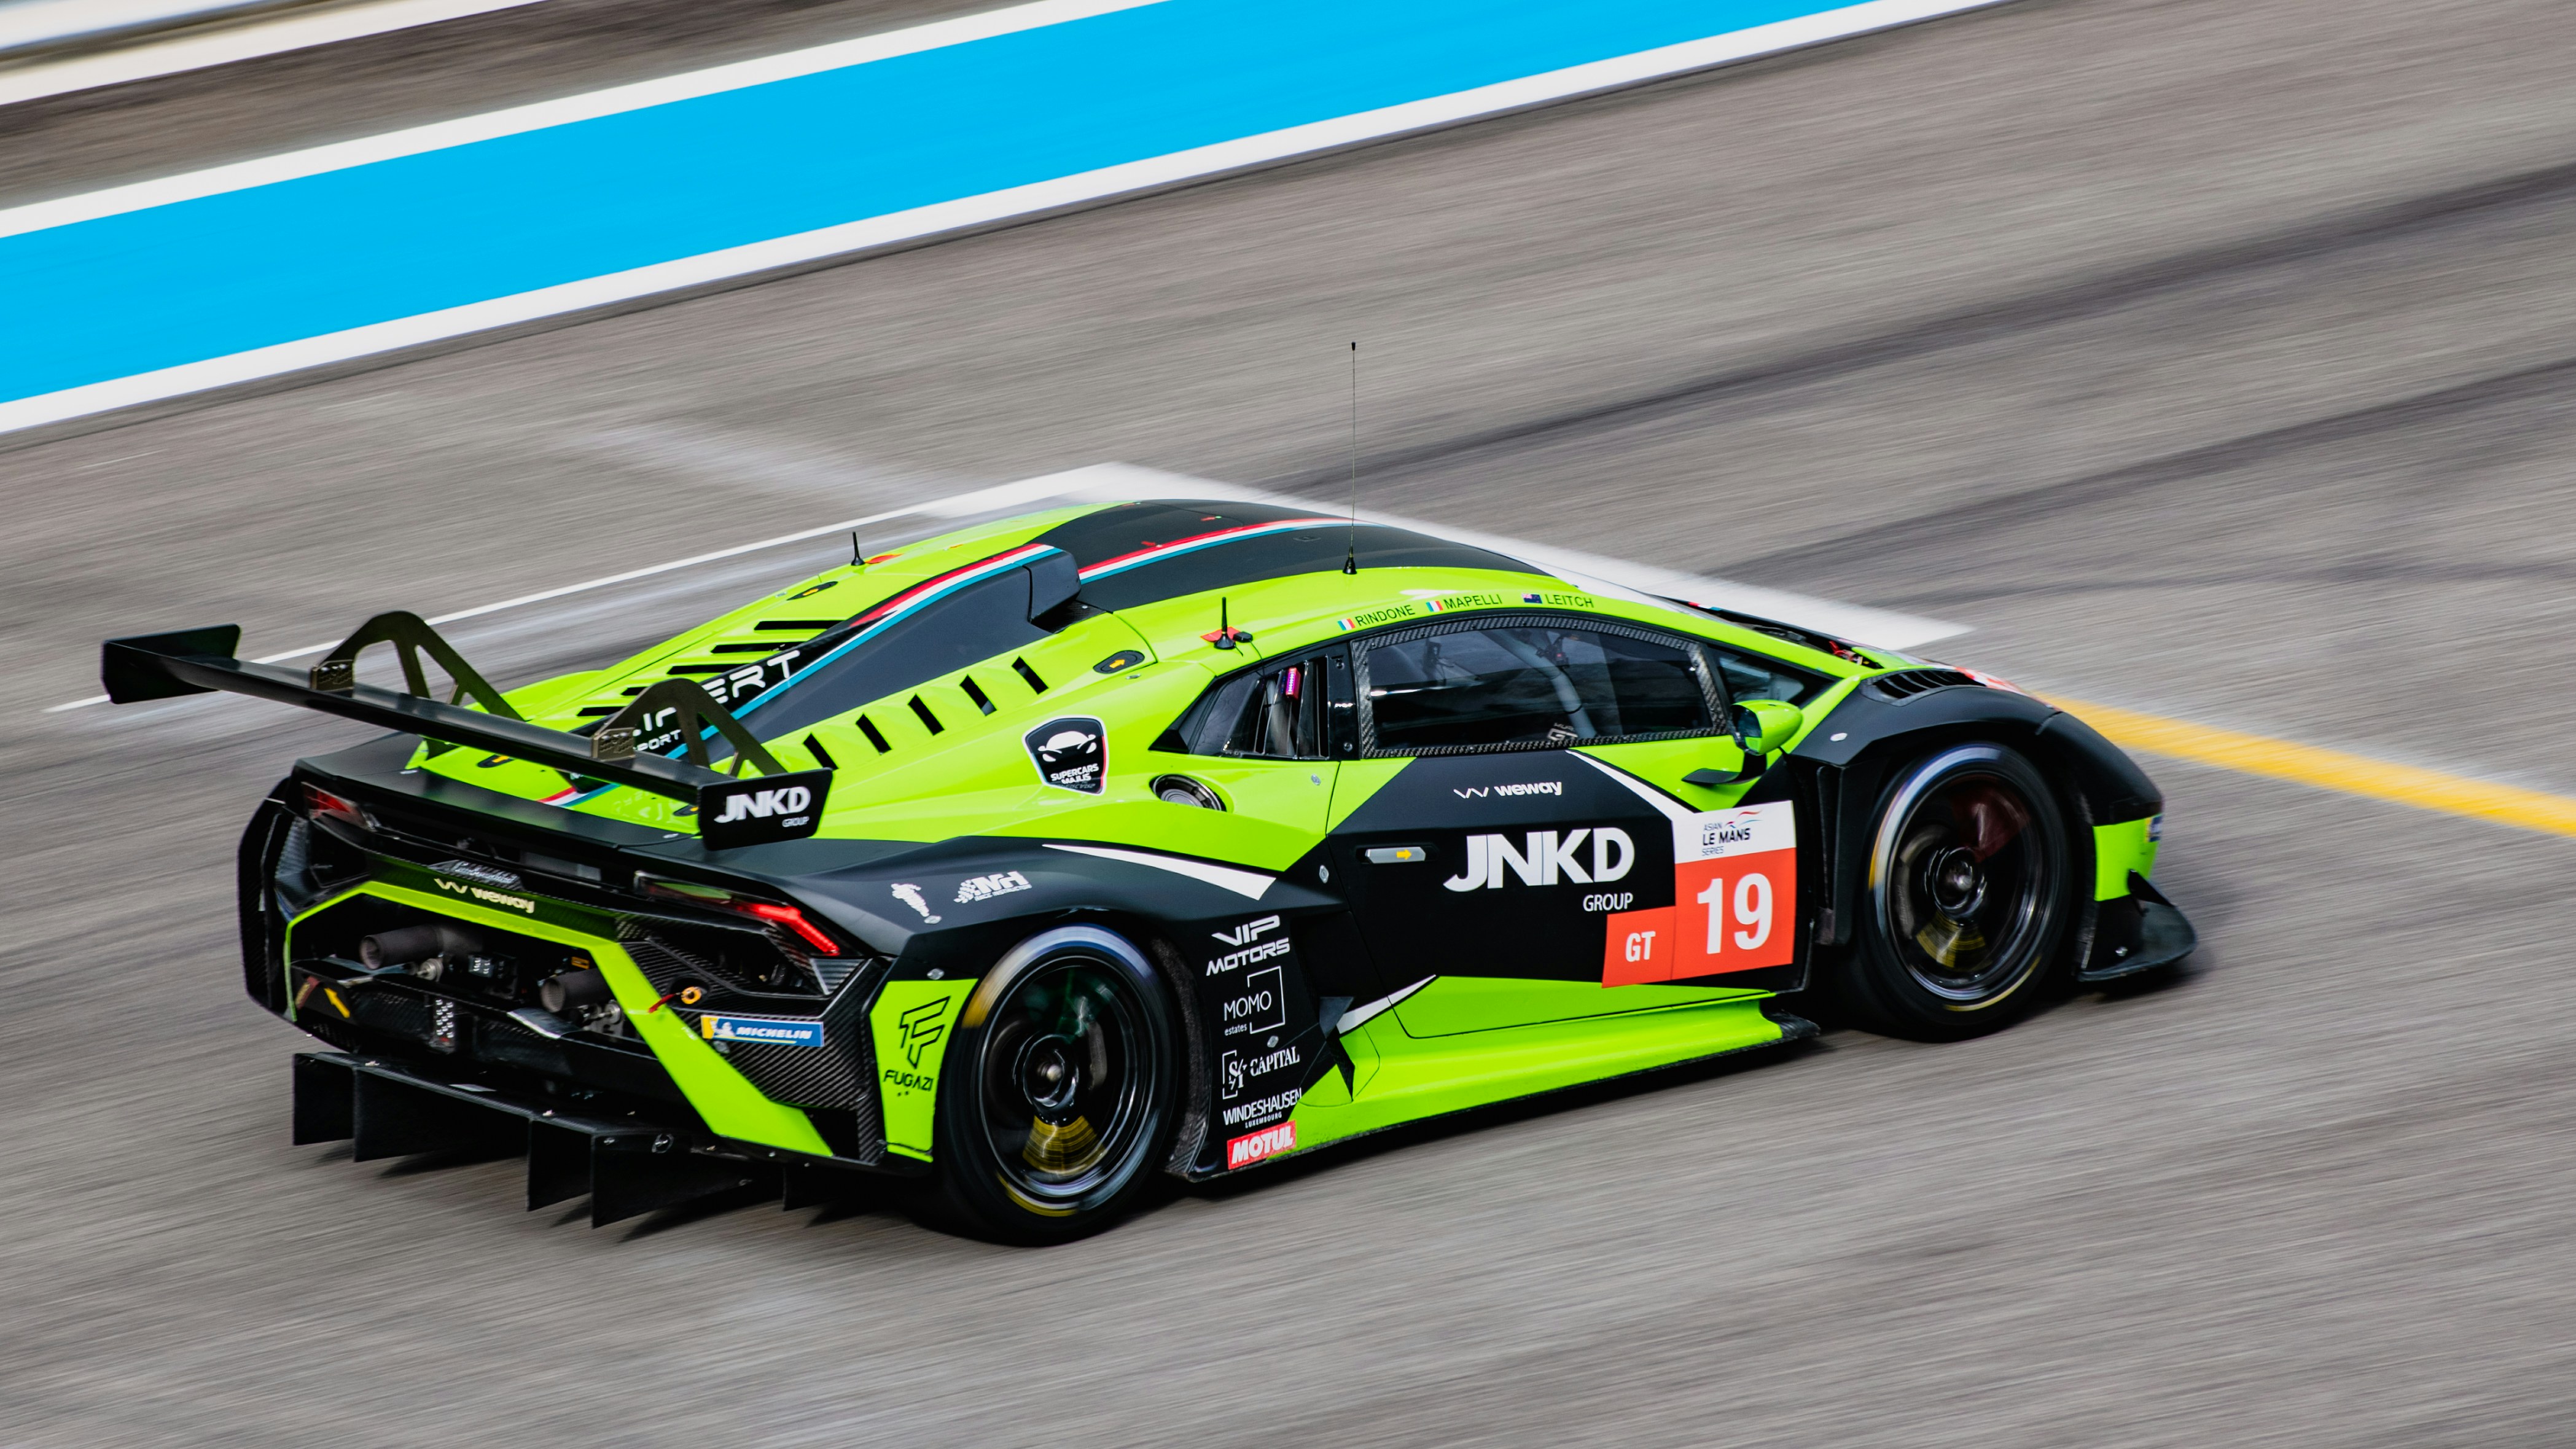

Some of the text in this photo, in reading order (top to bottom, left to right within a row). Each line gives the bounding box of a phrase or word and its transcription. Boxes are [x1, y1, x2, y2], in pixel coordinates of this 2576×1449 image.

[1443, 593, 1503, 610] MAPELLI
[1545, 593, 1594, 608] LEITCH
[1355, 604, 1416, 627] RINDONE
[1050, 763, 1099, 781] SUPERCARS
[1061, 773, 1091, 784] MAJLIS
[1494, 781, 1562, 796] weway
[714, 786, 811, 824] JNKD
[1703, 827, 1751, 846] LE MANS
[1704, 822, 1722, 831] ASIAN
[1443, 827, 1635, 892] JNKD
[1702, 846, 1724, 856] SERIES
[1583, 892, 1634, 912] GROUP
[1696, 872, 1774, 955] 19
[1211, 915, 1281, 946] VIP
[1206, 937, 1290, 977] MOTORS
[1625, 931, 1656, 962] GT
[1224, 991, 1271, 1021] MOMO
[736, 1026, 813, 1039] MICHELIN
[1224, 1023, 1247, 1036] estates
[1250, 1046, 1300, 1076] CAPITAL
[883, 1069, 934, 1092] FUGAZI
[1223, 1087, 1302, 1125] WINDESHAUSEN
[1245, 1112, 1282, 1128] LUXEMBOURG
[1231, 1126, 1294, 1164] MOTUL
